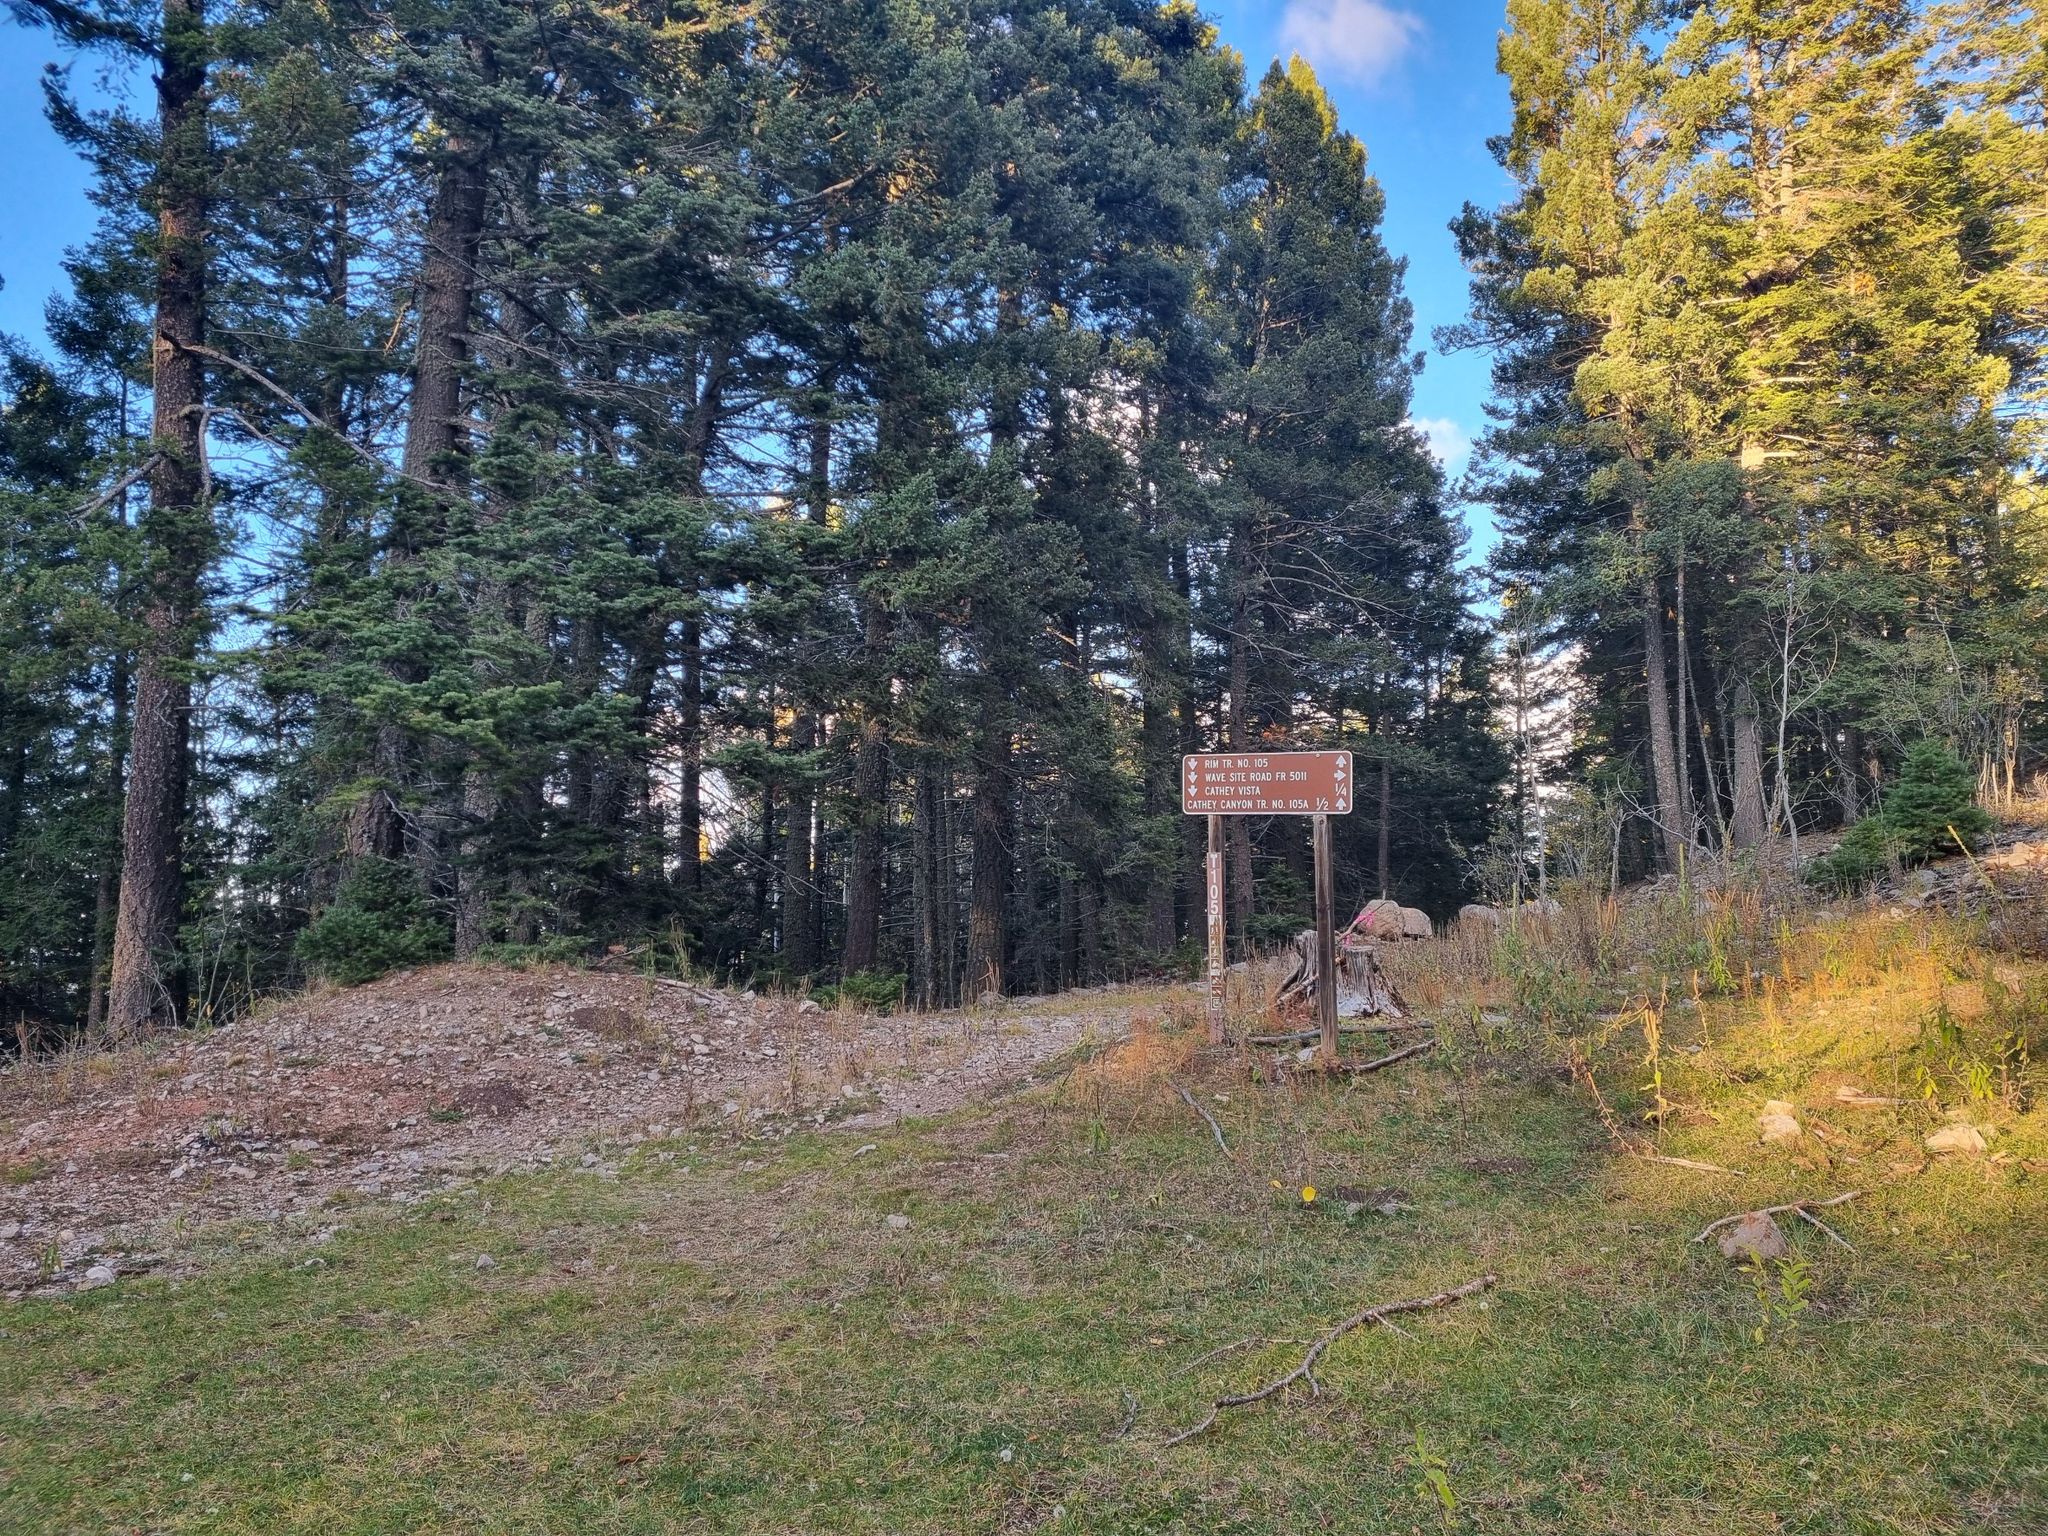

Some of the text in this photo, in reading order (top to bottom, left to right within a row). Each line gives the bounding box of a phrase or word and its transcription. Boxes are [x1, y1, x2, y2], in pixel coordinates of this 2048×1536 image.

[1205, 759, 1268, 768] RIM TR. NO. 105
[1205, 772, 1307, 782] WAVE SITE ROAD FR 5011
[1205, 787, 1235, 795] CATHEY
[1239, 786, 1260, 795] VISTA
[1188, 800, 1216, 809] CATHEY
[1221, 800, 1252, 809] CANYON
[1257, 800, 1268, 808] TR.
[1272, 800, 1285, 808] NO.
[1289, 800, 1308, 808] 105A
